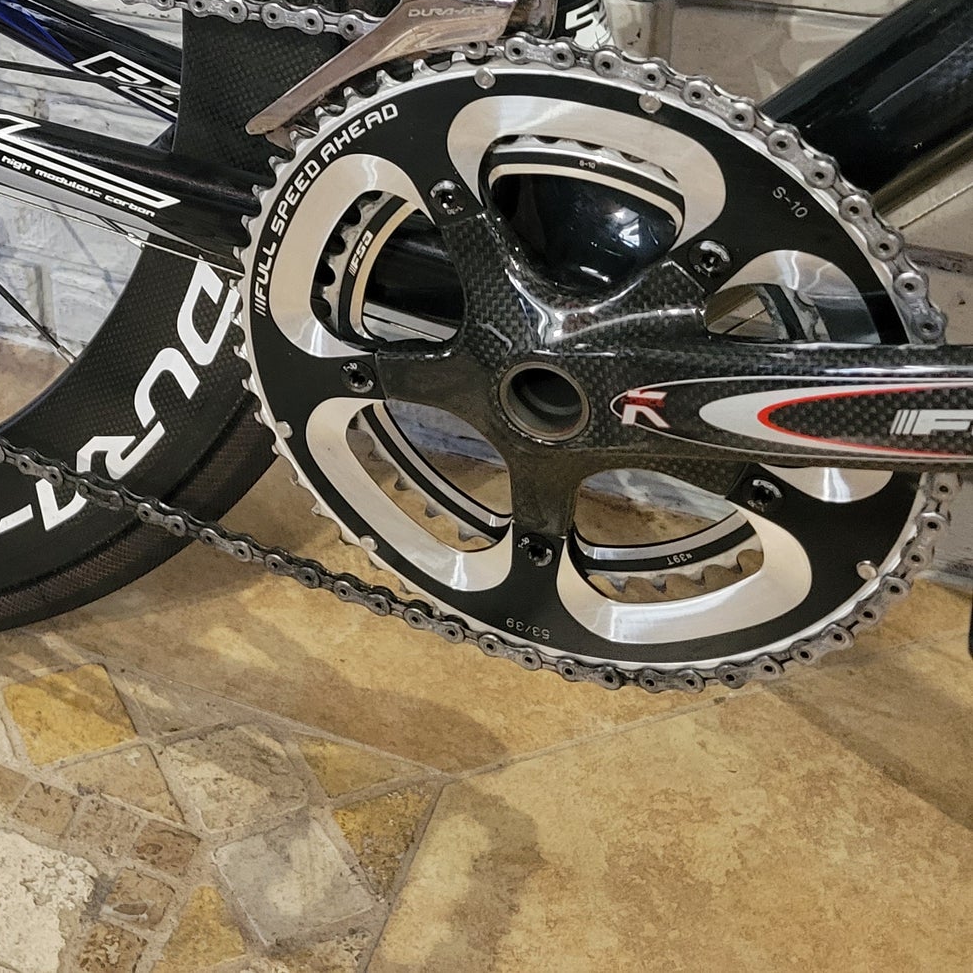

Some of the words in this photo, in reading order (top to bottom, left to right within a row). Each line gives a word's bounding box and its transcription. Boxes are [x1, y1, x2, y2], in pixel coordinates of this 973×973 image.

[0, 154, 32, 171] high
[104, 194, 156, 218] carbon
[255, 242, 278, 306] FULL
[271, 159, 321, 237] SPEED
[320, 103, 399, 164] AHEAD
[772, 186, 808, 218] S-10
[506, 617, 550, 640] 53/39
